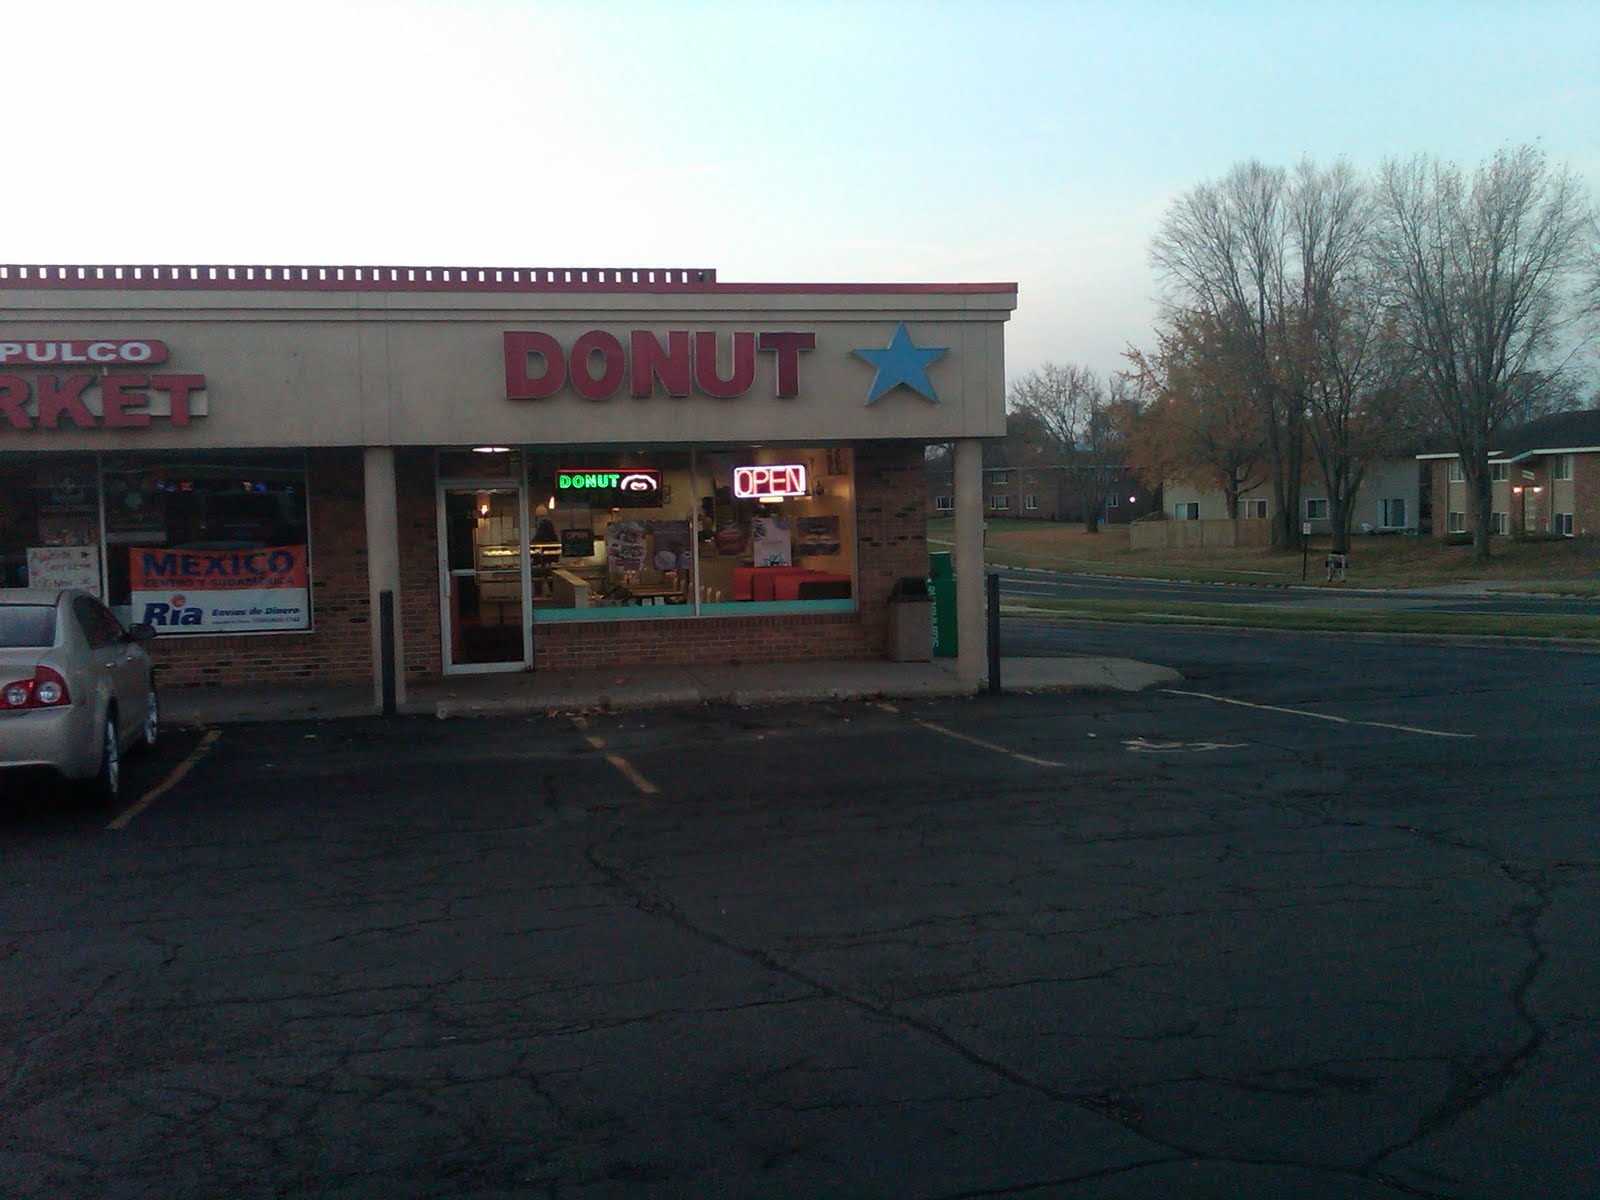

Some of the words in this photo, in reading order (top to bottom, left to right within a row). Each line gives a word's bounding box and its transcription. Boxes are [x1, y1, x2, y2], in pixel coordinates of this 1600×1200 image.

[0, 341, 152, 362] PULCO
[502, 329, 817, 400] DONUT
[559, 474, 620, 489] DONUT
[736, 468, 804, 495] OPEN
[141, 551, 294, 577] MEXICO
[143, 594, 203, 626] Ria
[249, 606, 263, 616] de
[265, 606, 300, 615] Dinero
